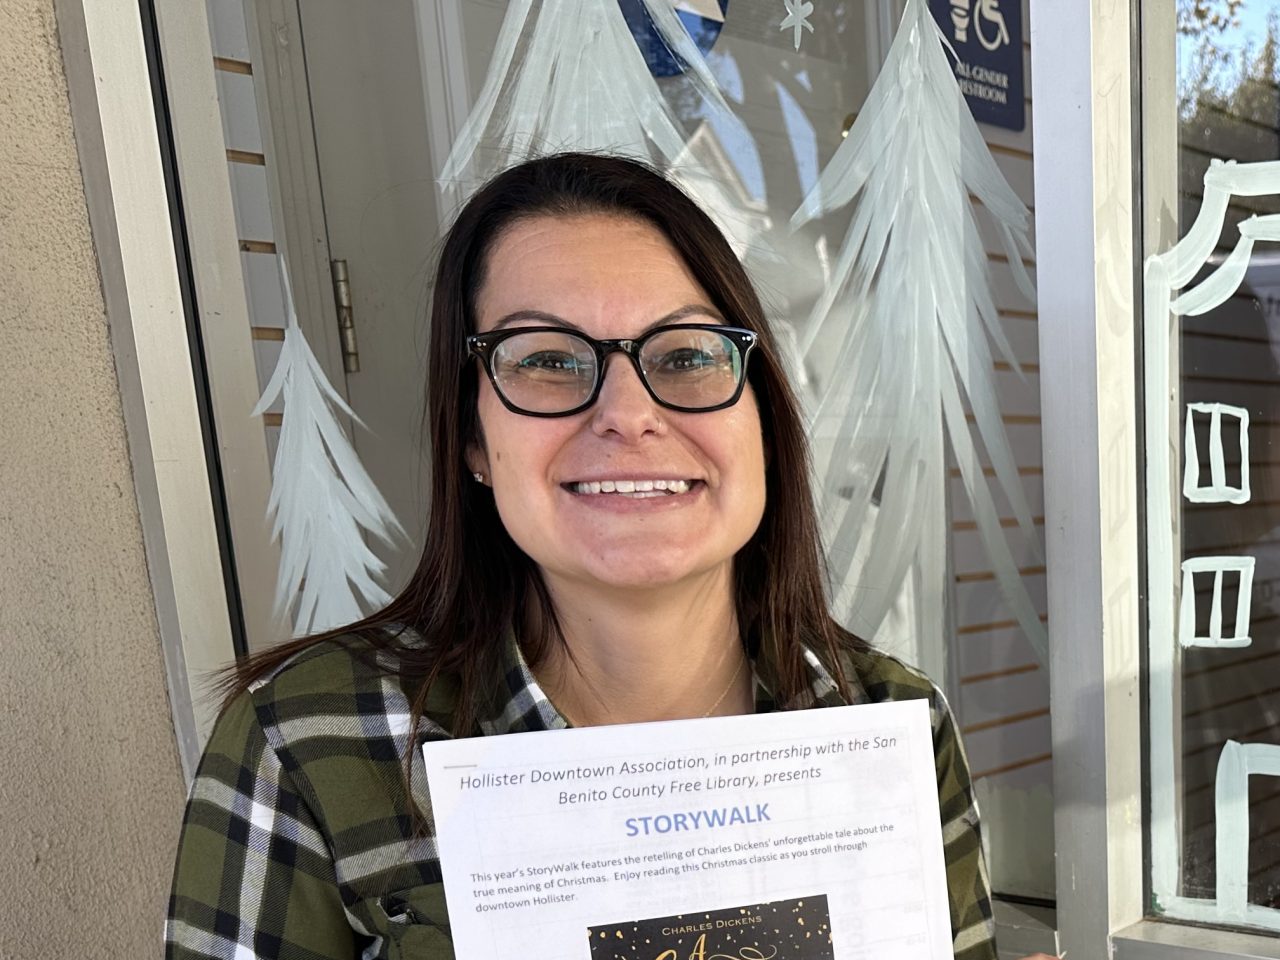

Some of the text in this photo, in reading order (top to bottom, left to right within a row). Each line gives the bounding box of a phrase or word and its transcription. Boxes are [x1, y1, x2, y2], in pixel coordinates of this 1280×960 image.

[459, 735, 897, 790] Hollister Downtown Association, in partnership with the San
[557, 766, 822, 805] Benito County Free Library, presents
[624, 802, 771, 837] STORYWALK
[469, 871, 493, 883] This
[525, 861, 580, 877] StoryWalk
[580, 857, 623, 870] features
[622, 854, 641, 865] the
[642, 850, 684, 863] retelling
[683, 847, 696, 858] of
[696, 844, 733, 857] Charles
[772, 830, 834, 847] unforgettable
[834, 827, 852, 839] tale
[852, 824, 879, 837] about
[878, 823, 894, 833] the
[472, 887, 495, 898] true
[496, 880, 542, 895] meaning
[542, 877, 555, 890] of
[613, 870, 641, 882] Enjoy
[642, 865, 681, 878] reading
[680, 862, 700, 873] this
[700, 857, 748, 871] Christmas
[748, 851, 778, 864] classic
[778, 851, 790, 860] as
[790, 849, 809, 860] you
[809, 844, 832, 856] stroll
[832, 839, 868, 853] through
[474, 898, 531, 913] downtown
[662, 915, 762, 936] CHARLES DICKENS
